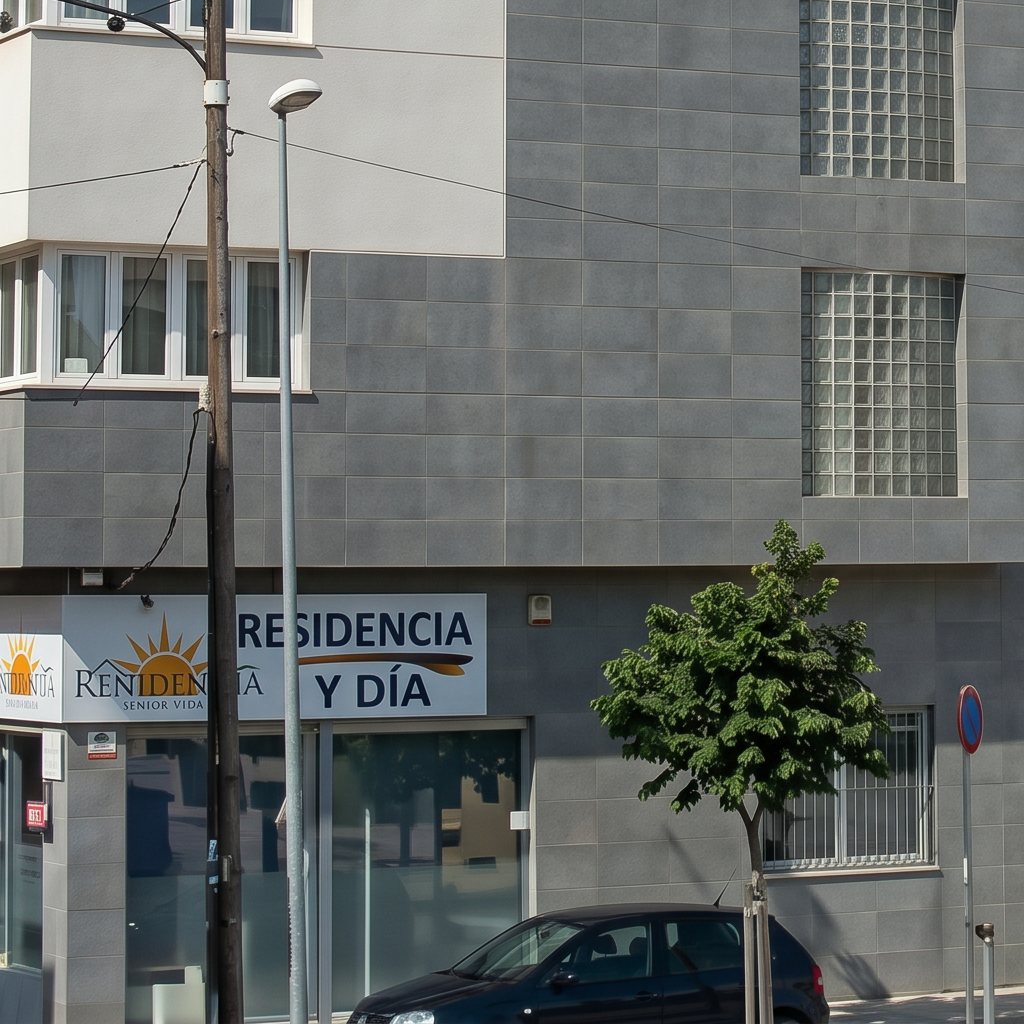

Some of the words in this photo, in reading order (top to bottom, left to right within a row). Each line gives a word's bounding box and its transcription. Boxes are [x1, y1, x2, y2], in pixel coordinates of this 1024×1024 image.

[237, 611, 473, 648] RESIDENCIA
[75, 669, 265, 698] RENIDENIA
[314, 674, 342, 709] Y
[356, 664, 432, 708] DÍA
[123, 700, 169, 711] SENIOR
[173, 699, 204, 710] VIDA
